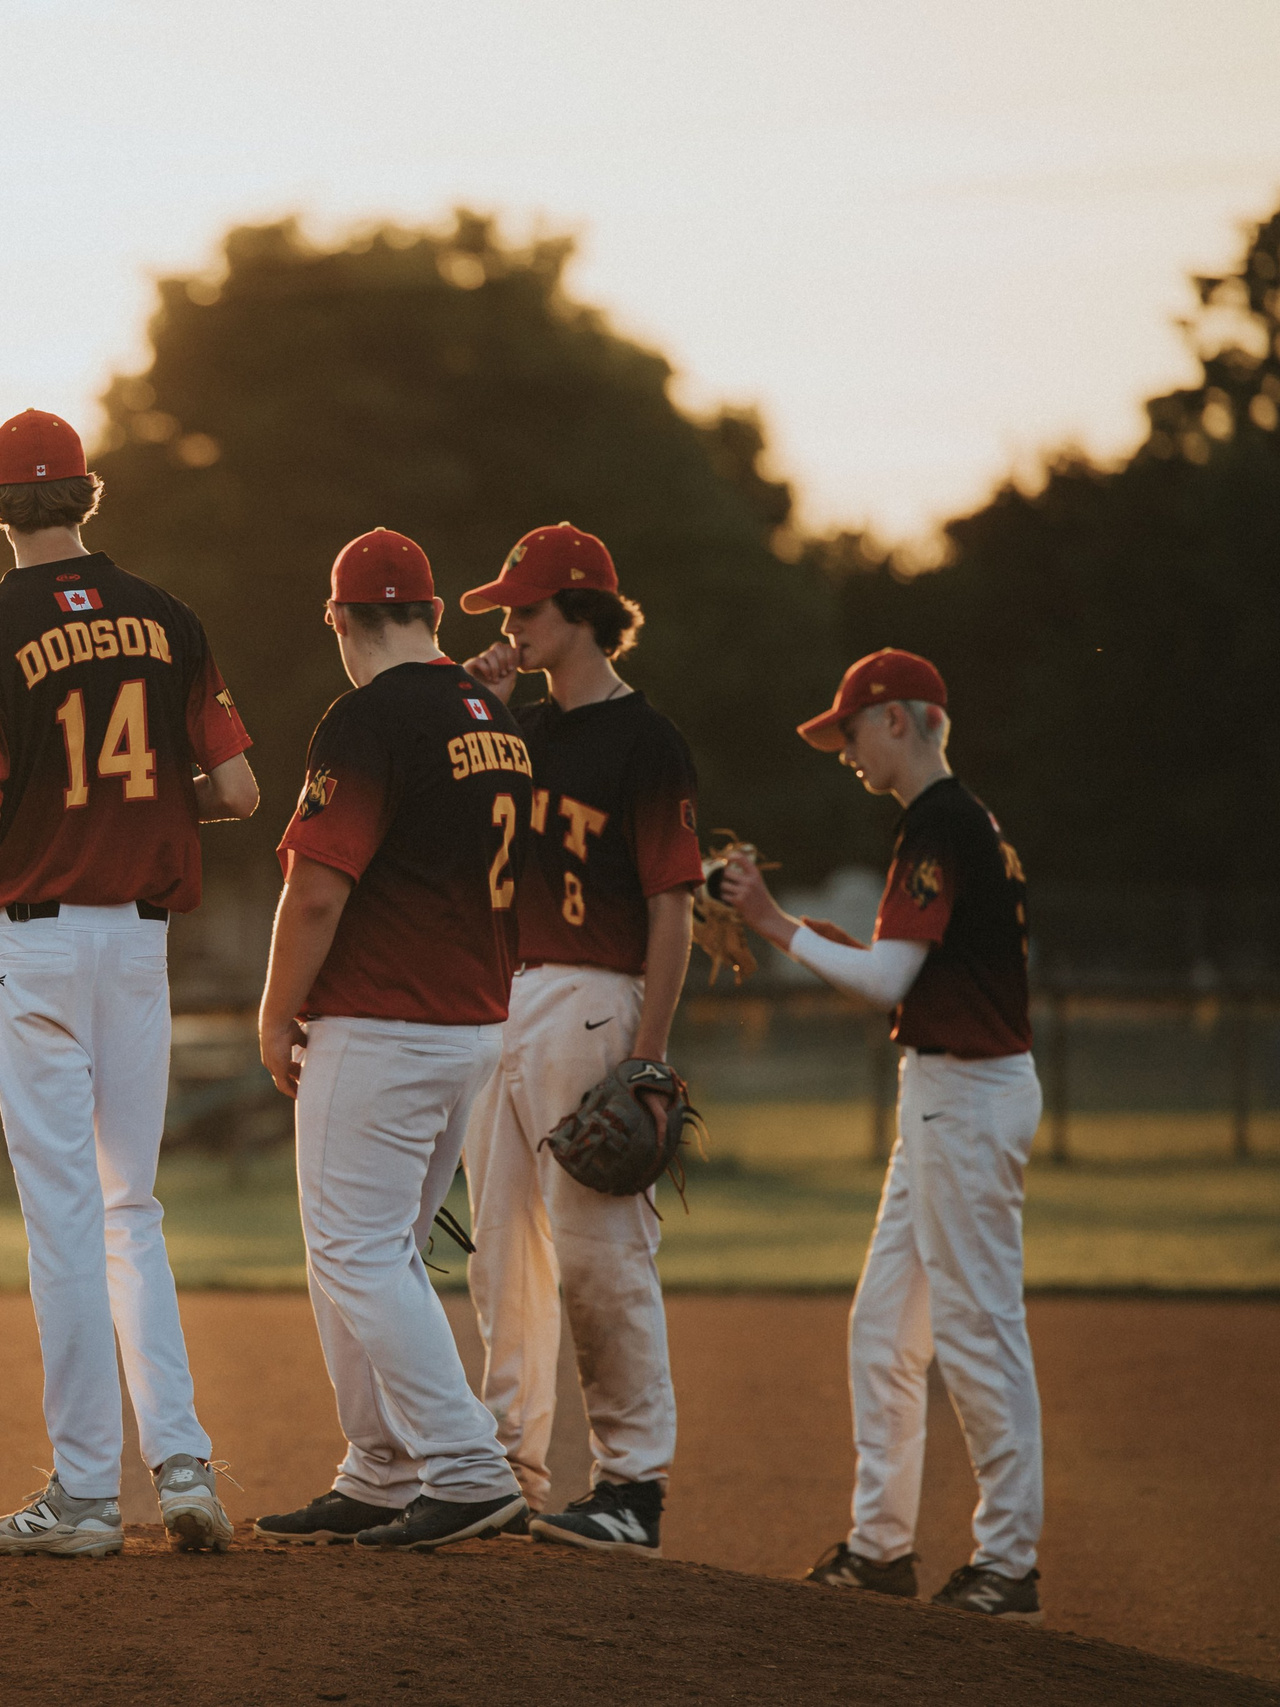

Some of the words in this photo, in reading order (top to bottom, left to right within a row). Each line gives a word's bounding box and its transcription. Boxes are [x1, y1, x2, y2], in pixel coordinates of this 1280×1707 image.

[15, 616, 173, 690] DODSON
[55, 678, 158, 810] 14
[562, 870, 584, 926] 8
[13, 1500, 60, 1534] N
